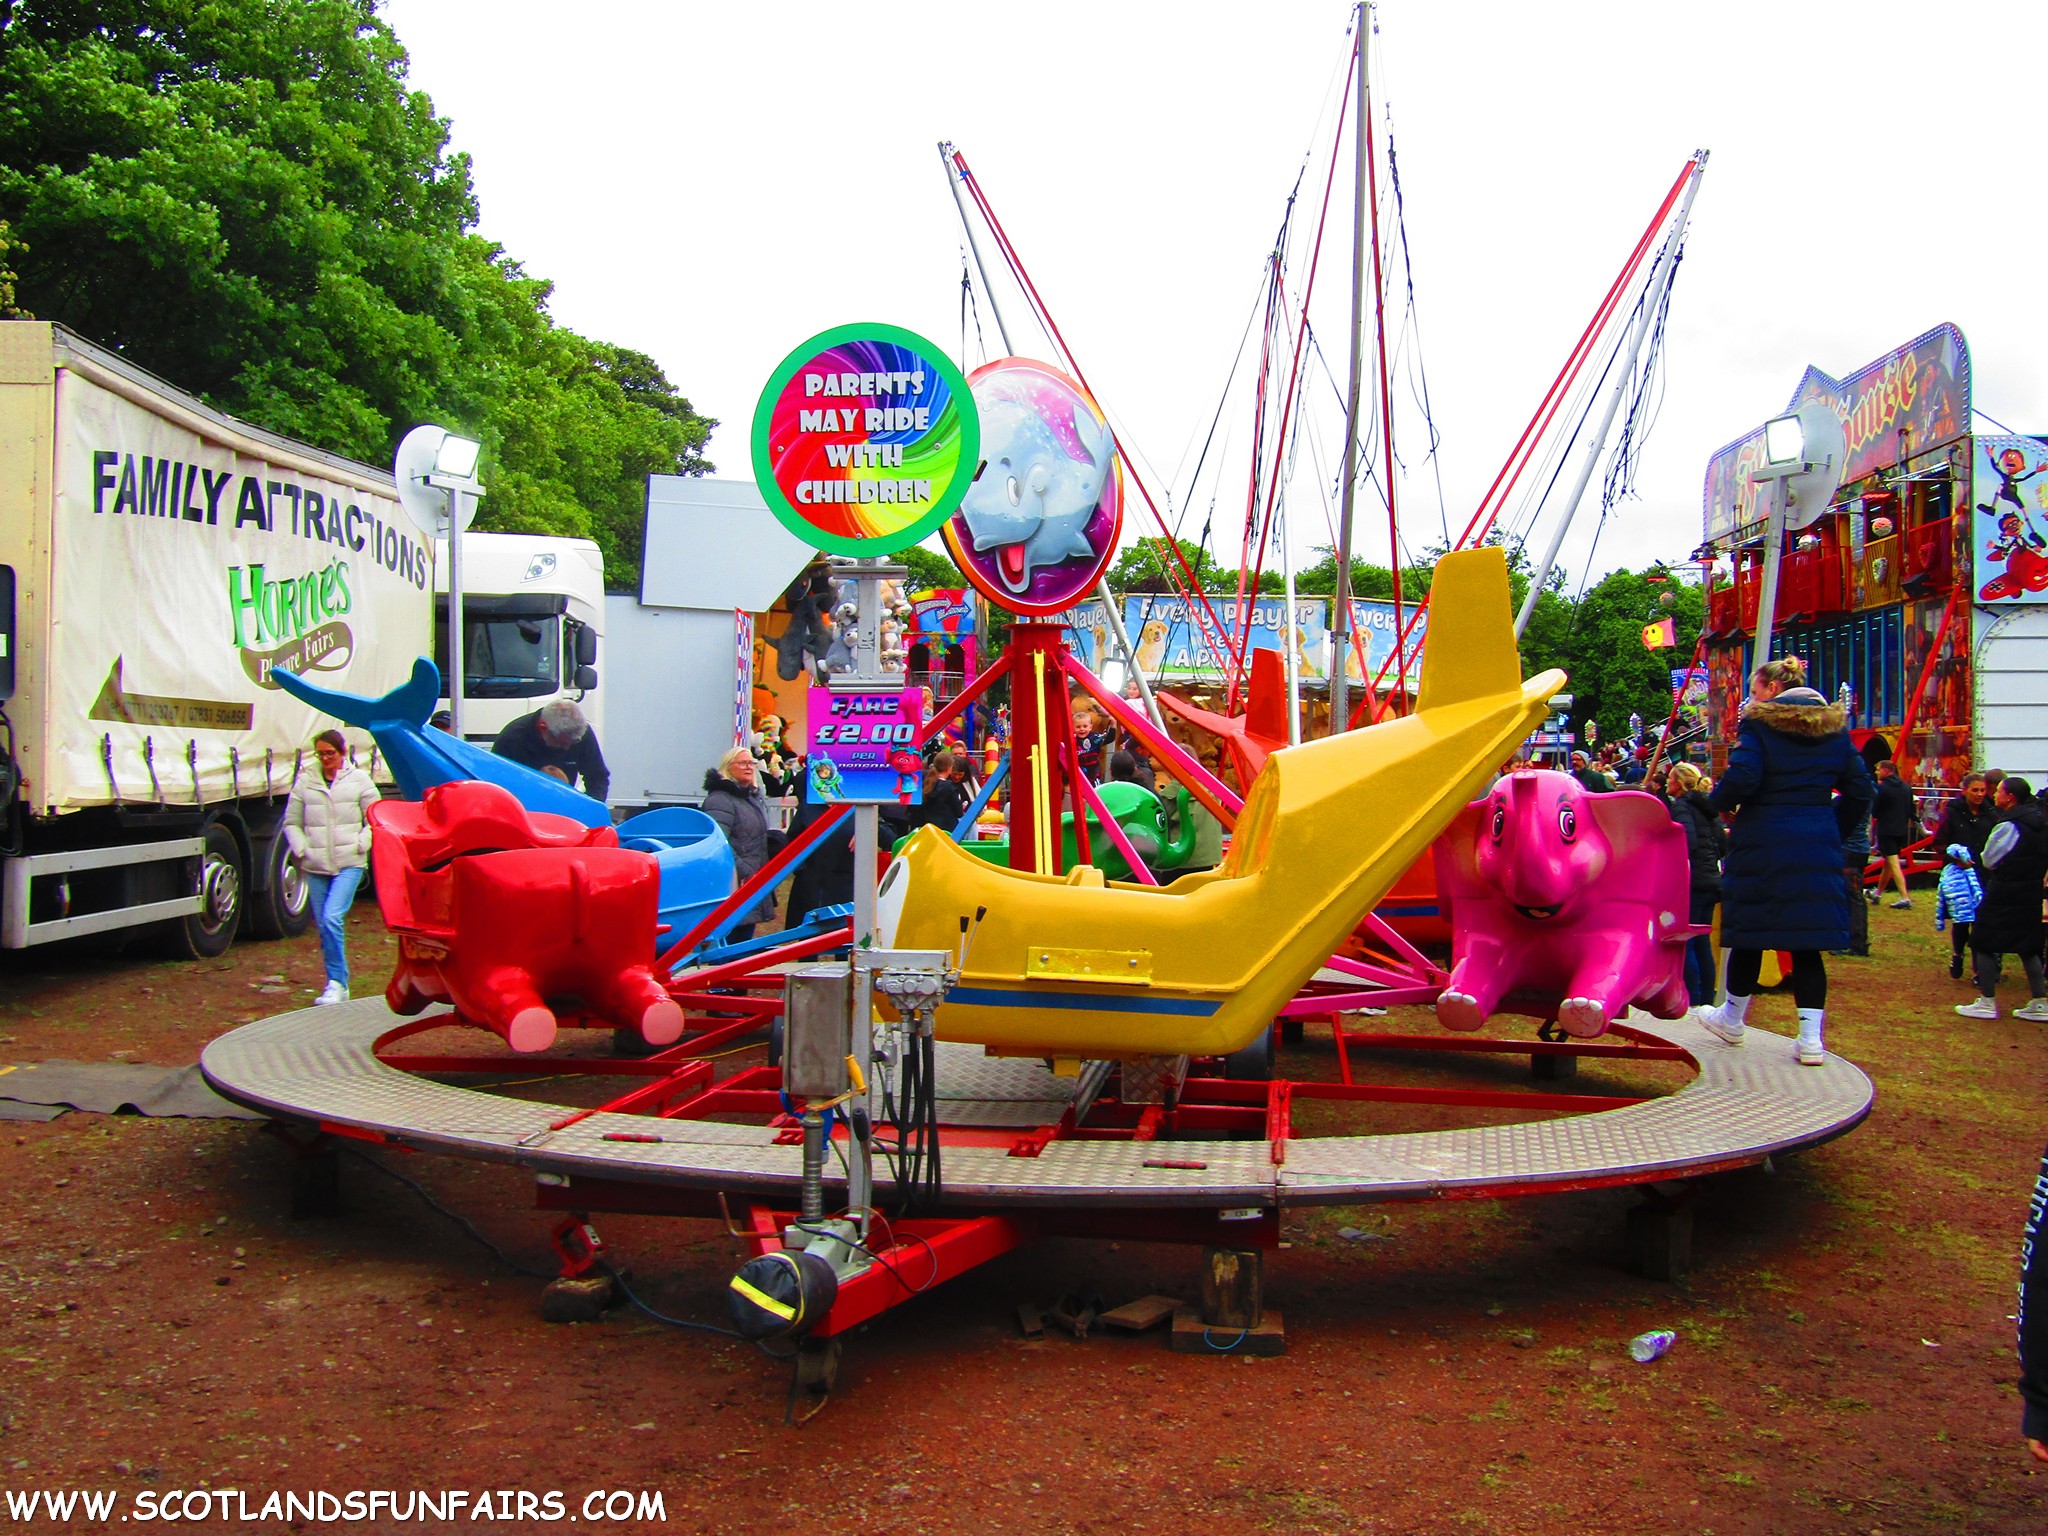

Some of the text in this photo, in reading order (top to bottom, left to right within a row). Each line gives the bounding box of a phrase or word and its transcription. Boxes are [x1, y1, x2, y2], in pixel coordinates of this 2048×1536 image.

[804, 371, 925, 398] PARENTS
[799, 406, 929, 433] MAY RIDE
[825, 442, 903, 468] WITH
[795, 478, 931, 505] CHILDREN
[93, 450, 426, 591] FAMILY ATTRACTIONS
[304, 630, 335, 662] Fairs
[830, 696, 900, 718] FARE
[815, 723, 915, 744] £2.00
